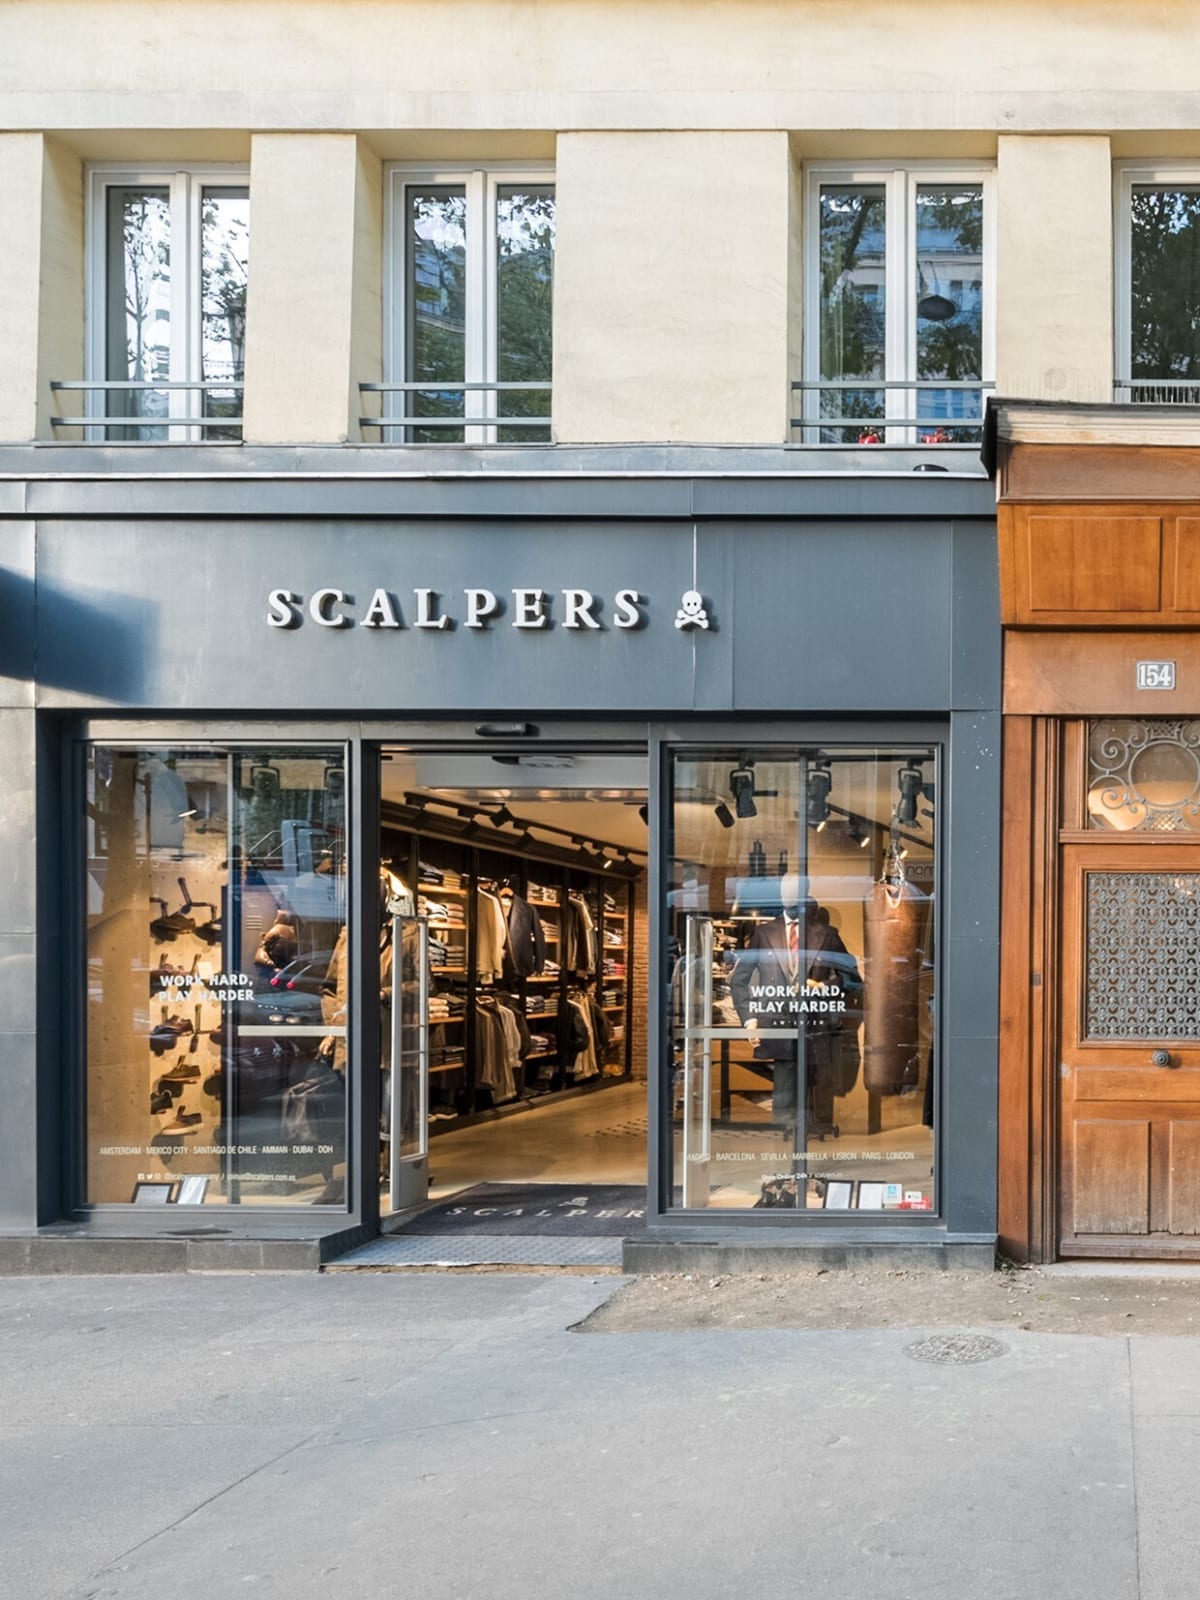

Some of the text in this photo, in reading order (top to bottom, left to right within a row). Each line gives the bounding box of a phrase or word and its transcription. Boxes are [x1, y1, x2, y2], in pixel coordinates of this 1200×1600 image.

[266, 588, 641, 629] SCALPERS
[1139, 664, 1172, 687] 154
[160, 974, 254, 987] WORK HARD,
[158, 989, 255, 1002] PLAY HARDER
[750, 984, 846, 998] WORK HARD,
[748, 1000, 847, 1013] PLAY HARDER
[146, 1146, 172, 1155] MEXICO
[172, 1146, 189, 1154] CITY
[193, 1145, 226, 1154] SANTIAGO
[227, 1145, 237, 1154] DE
[237, 1145, 257, 1154] CHILE
[261, 1145, 289, 1154] AMMAN
[292, 1145, 314, 1154] DUBAI
[715, 1152, 756, 1161] BARCELONA
[760, 1152, 788, 1161] SEVILLA
[792, 1152, 828, 1160] MARBELLA
[832, 1152, 857, 1160] LISBON
[862, 1152, 881, 1160] PARIS
[885, 1151, 915, 1160] LONDON
